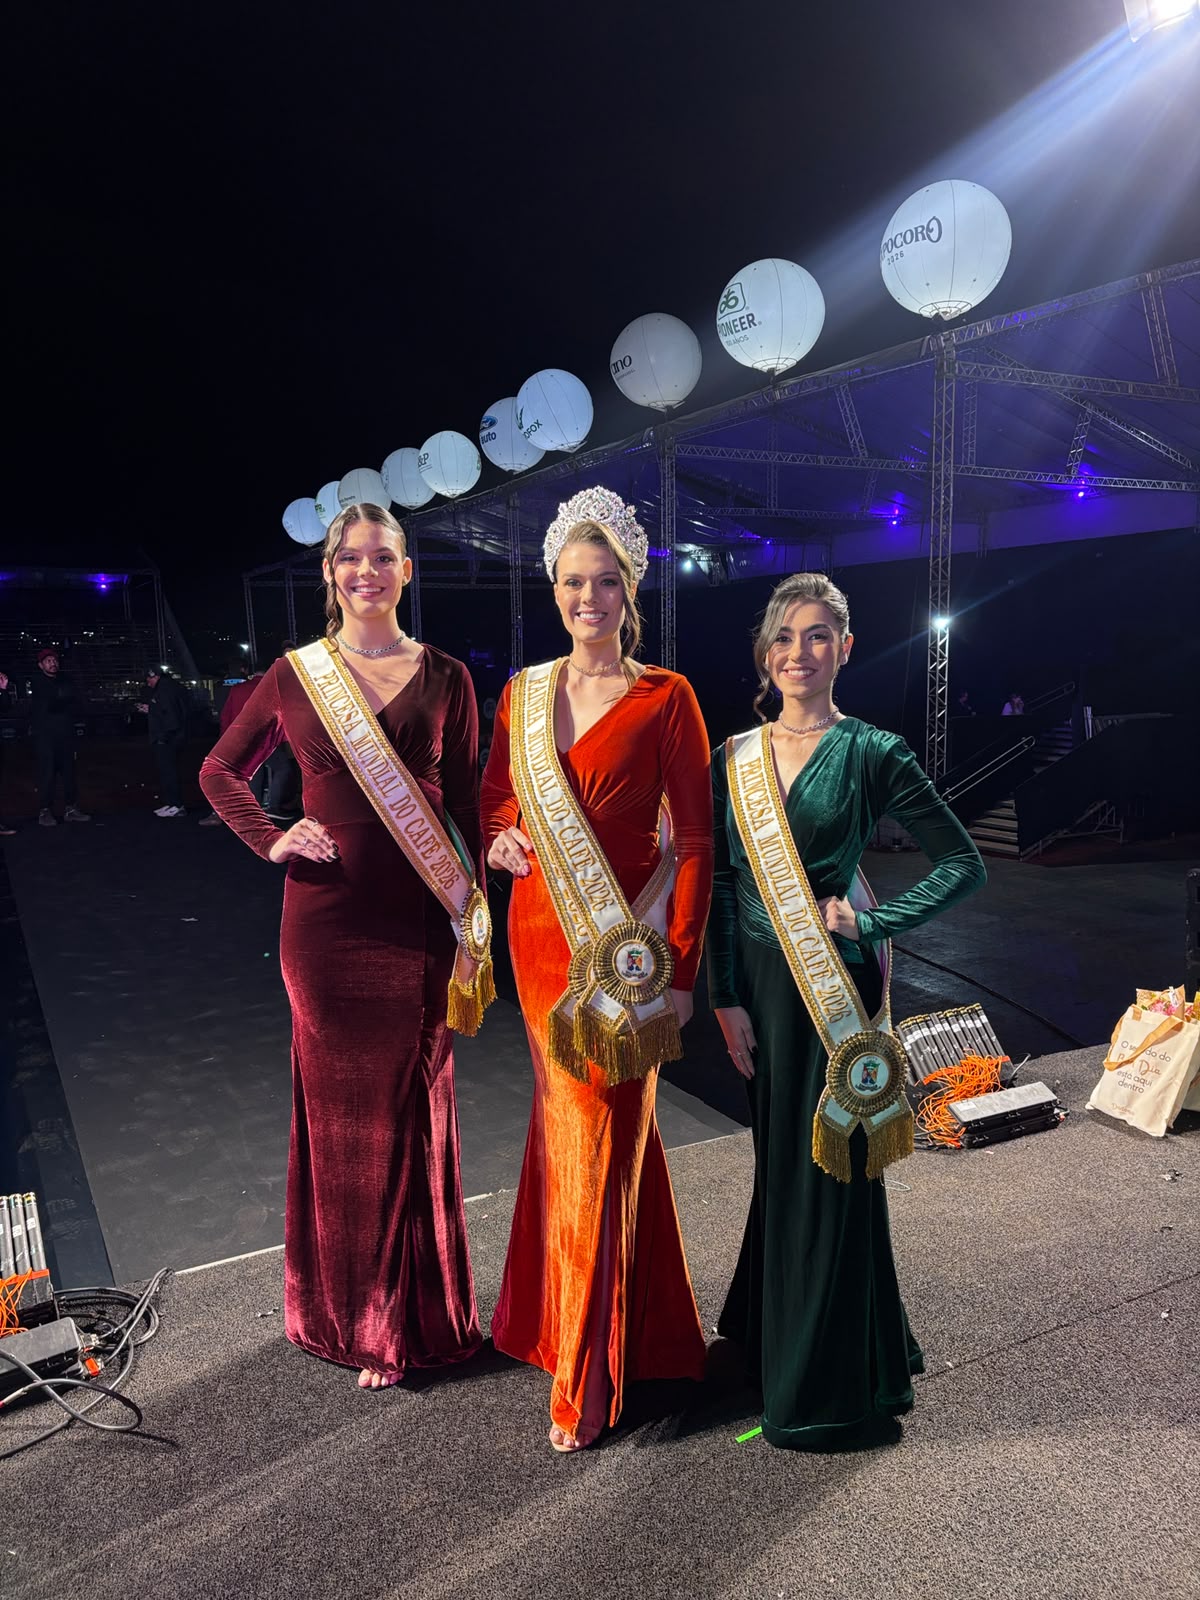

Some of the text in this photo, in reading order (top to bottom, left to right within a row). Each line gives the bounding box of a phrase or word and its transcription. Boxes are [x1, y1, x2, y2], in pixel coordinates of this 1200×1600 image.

[887, 250, 904, 265] 2026
[527, 675, 549, 728] RAINHA
[527, 725, 558, 798] MUNDIAL
[313, 669, 363, 736] PRINCESA
[350, 731, 402, 799] MUNDIAL
[388, 794, 417, 819] DO
[429, 855, 460, 890] 2026
[544, 796, 571, 823] DO
[580, 872, 615, 912] 2026
[739, 757, 774, 832] PRINCESA
[757, 832, 800, 906] MUNDIAL
[783, 906, 812, 932] DO
[815, 984, 852, 1024] 2026
[1121, 1041, 1129, 1049] O
[1158, 1051, 1172, 1063] do
[1117, 1078, 1145, 1094] dentro
[1133, 1075, 1153, 1088] aqui
